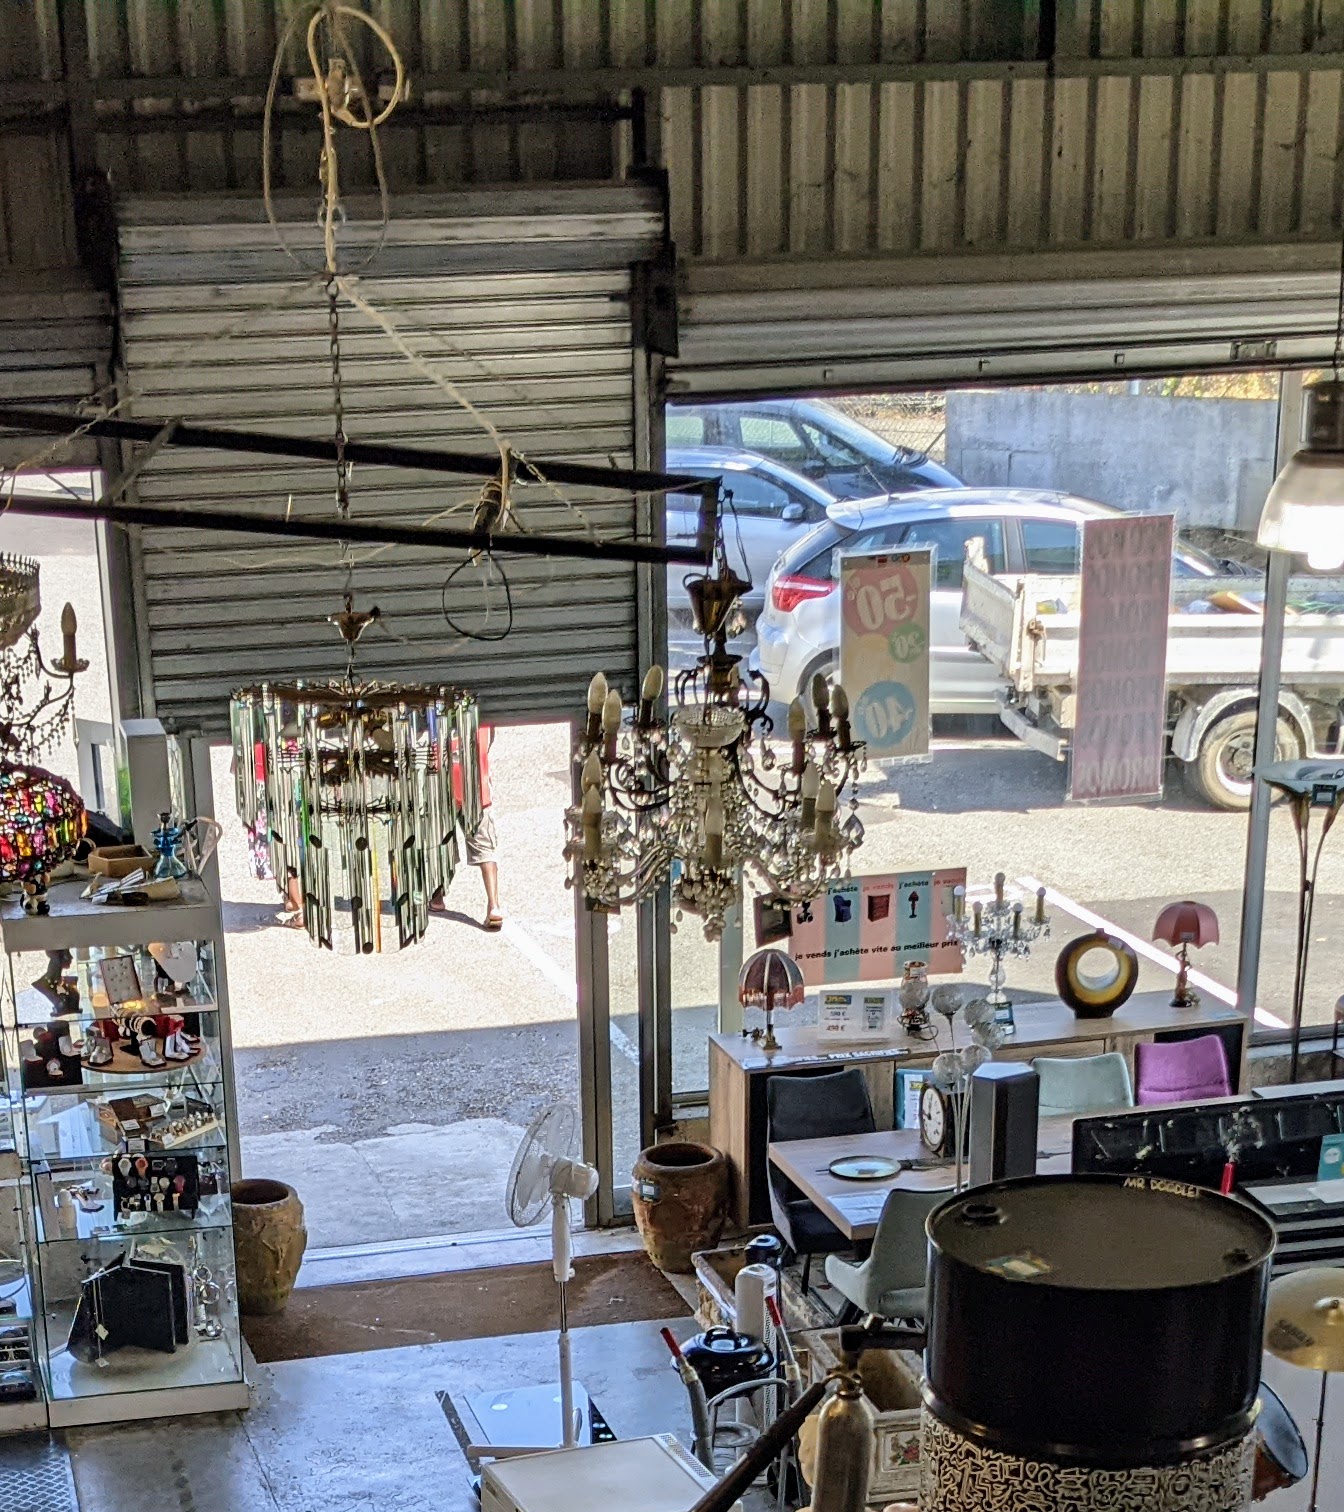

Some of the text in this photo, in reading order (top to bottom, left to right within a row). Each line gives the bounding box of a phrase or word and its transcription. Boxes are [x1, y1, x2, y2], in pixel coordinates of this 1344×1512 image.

[805, 950, 832, 959] vends
[871, 945, 888, 953] vite
[903, 941, 939, 951] meilleur
[1123, 1177, 1146, 1190] MR
